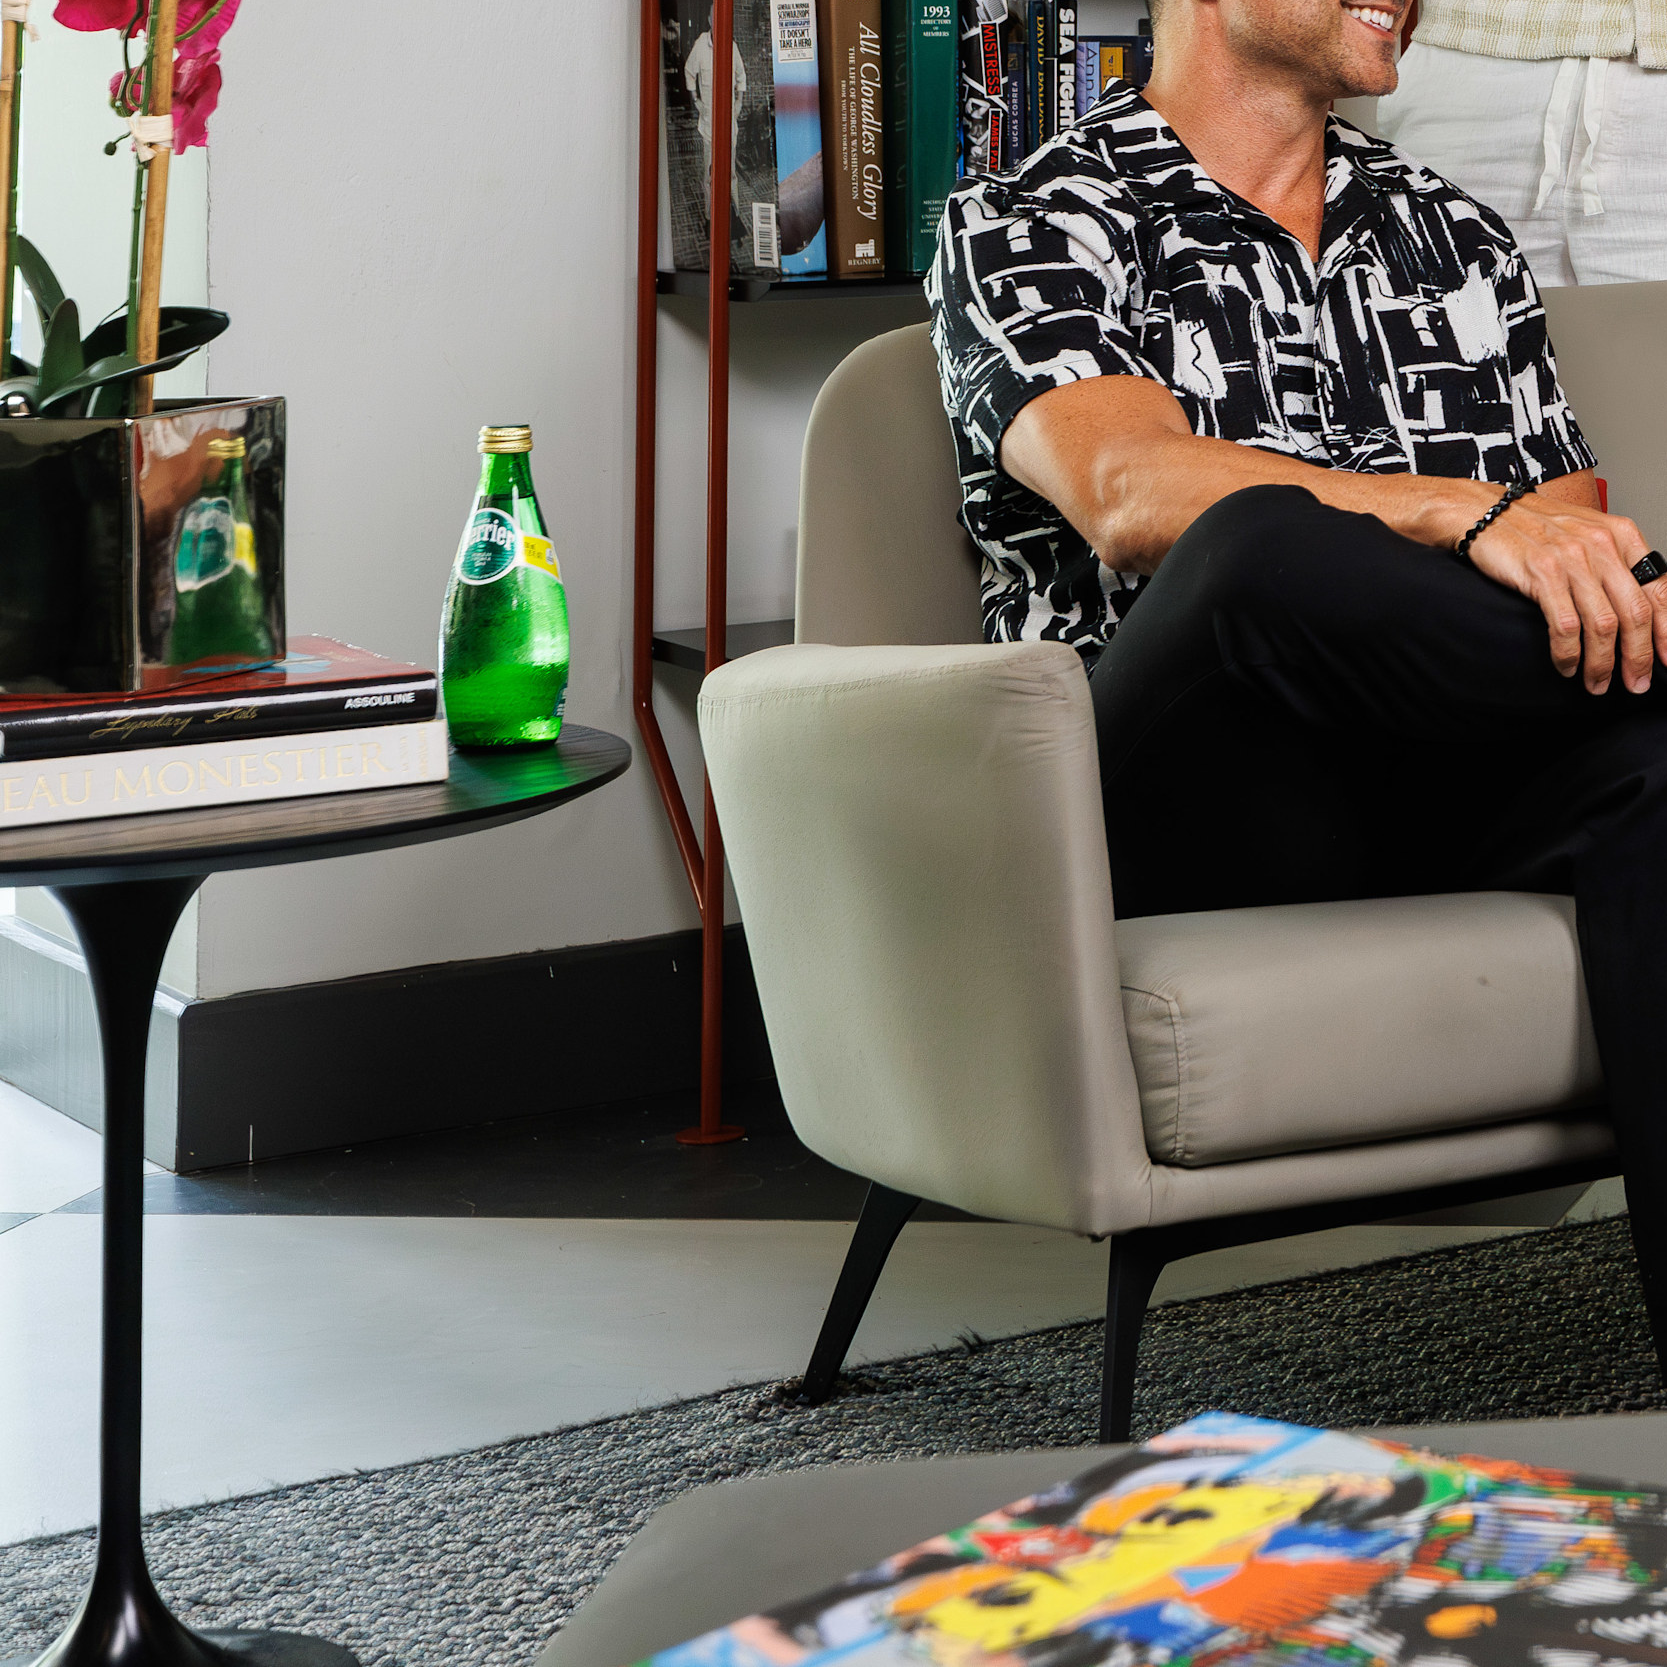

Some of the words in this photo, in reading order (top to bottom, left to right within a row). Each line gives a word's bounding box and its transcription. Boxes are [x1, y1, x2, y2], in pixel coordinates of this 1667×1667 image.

[922, 5, 951, 18] 1993
[859, 22, 880, 56] All
[1059, 8, 1075, 55] SEA
[848, 47, 856, 65] THE
[983, 24, 1000, 95] MISTRESS
[1087, 47, 1097, 91] Ann
[849, 88, 856, 99] OF
[860, 62, 882, 156] Cloudless
[1059, 63, 1075, 129] FIGHT
[850, 102, 858, 137] GEORGE
[990, 114, 999, 146] JAMES
[850, 139, 859, 200] WASHINGTON
[857, 163, 883, 220] Glory
[466, 519, 515, 551] errier
[344, 692, 416, 710] ASSOULINE
[2, 769, 93, 812] EAU
[112, 740, 394, 802] MONESTIER
